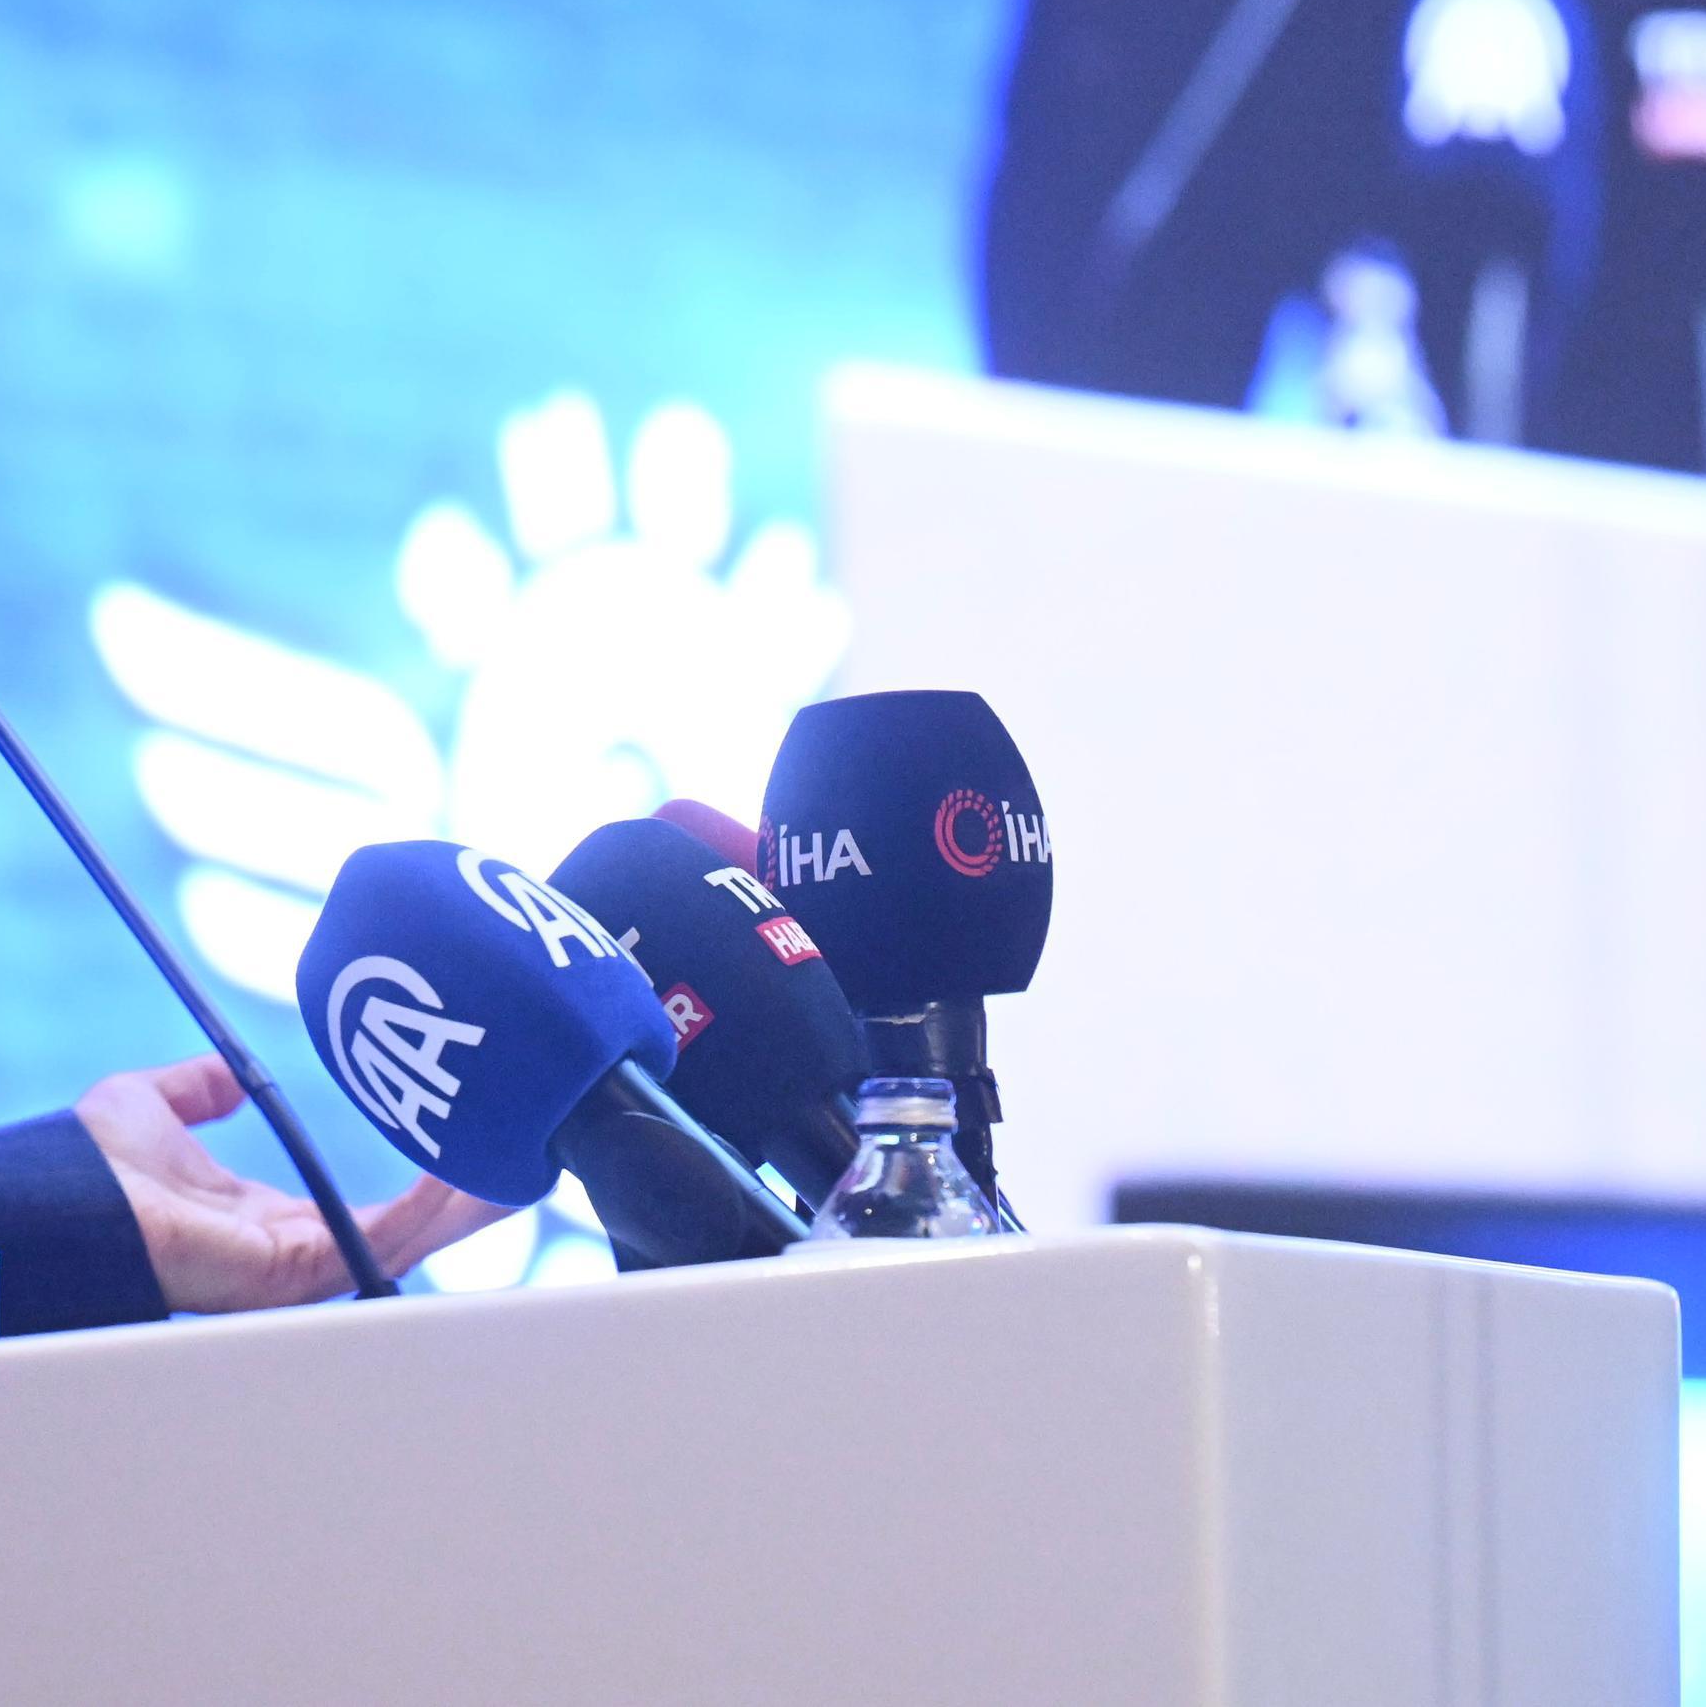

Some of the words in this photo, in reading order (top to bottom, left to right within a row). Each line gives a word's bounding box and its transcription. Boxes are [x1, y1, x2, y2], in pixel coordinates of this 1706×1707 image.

[779, 824, 873, 888] İHA
[703, 866, 787, 914] TR
[350, 995, 487, 1160] AA
